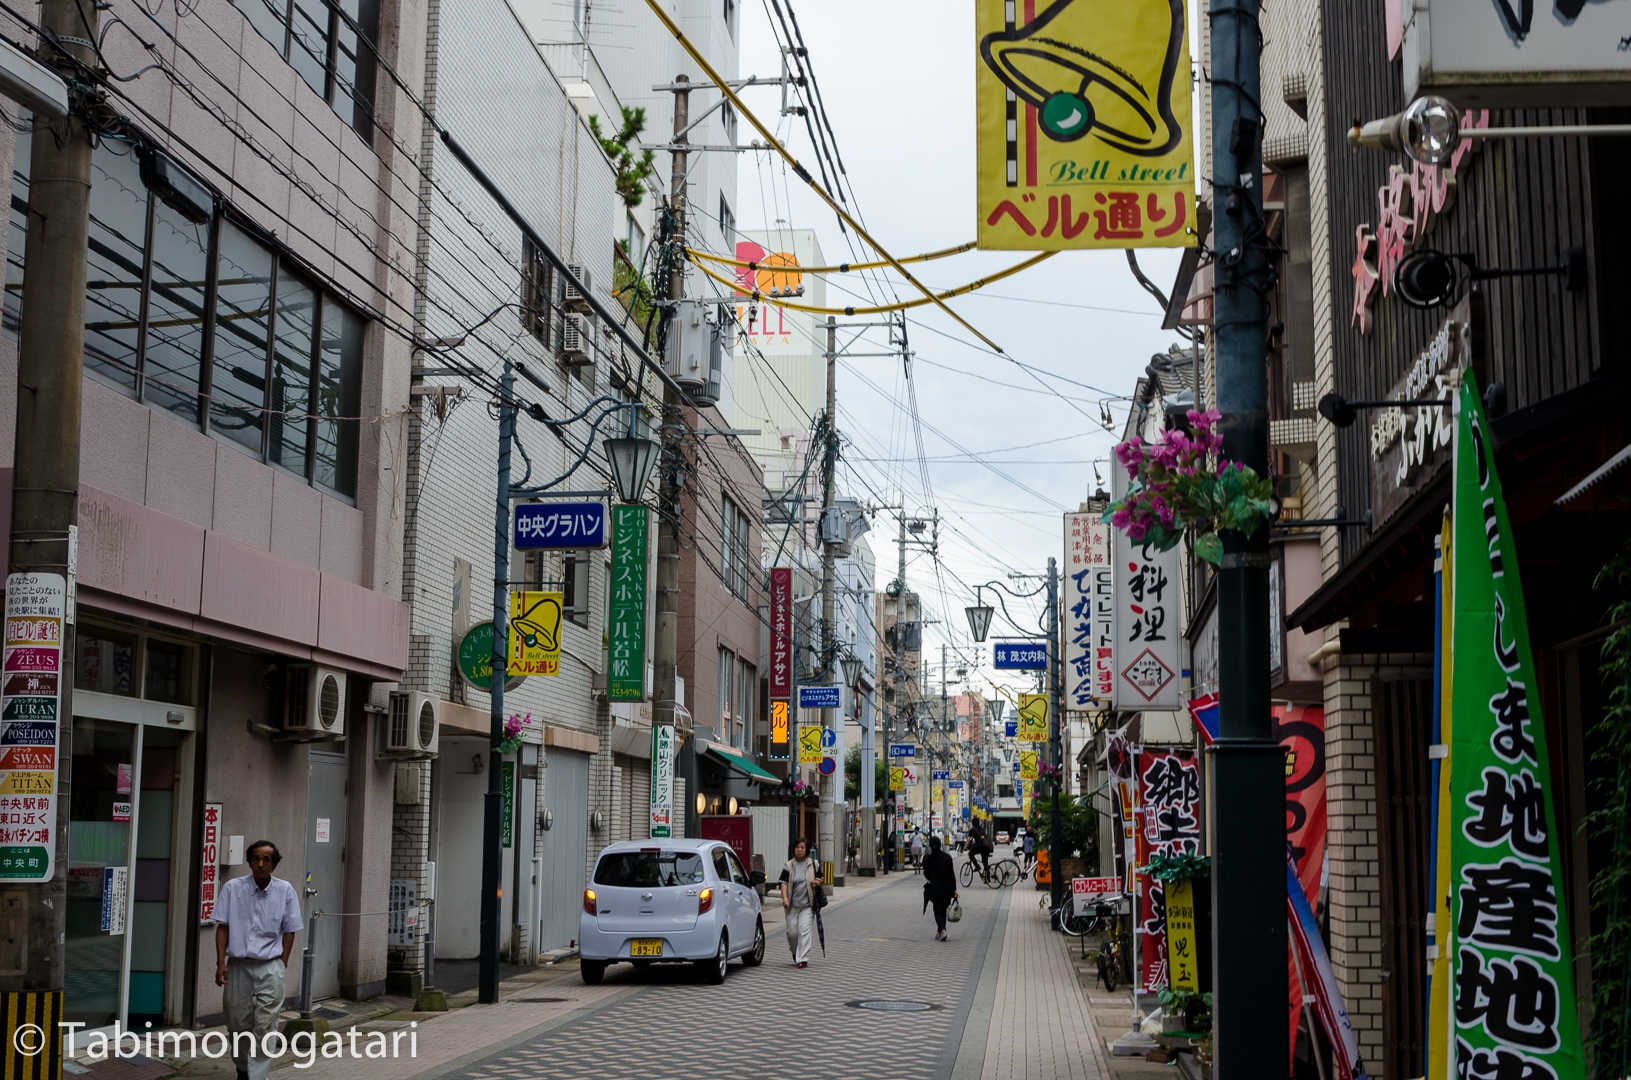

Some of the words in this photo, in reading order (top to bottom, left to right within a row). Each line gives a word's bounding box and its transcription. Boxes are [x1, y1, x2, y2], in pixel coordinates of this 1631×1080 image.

[1050, 160, 1110, 183] Bell
[1120, 161, 1188, 181] street
[987, 191, 1188, 240] ベル通り
[517, 514, 601, 539] 中央グラハン
[636, 509, 645, 556] HOTEL
[613, 508, 635, 677] ビジネスホテル若松
[1128, 543, 1168, 642] 料理
[633, 563, 643, 650] WAKAMATSU
[17, 655, 54, 665] ZEUS
[510, 660, 558, 674] ベル通り
[774, 651, 787, 686] アサヒ
[14, 704, 55, 715] JURAN
[8, 729, 54, 740] POSEIDON
[13, 753, 52, 764] SWAN
[11, 778, 52, 789] TITAN
[0, 797, 50, 810] 中央駅前
[119, 805, 130, 813] AED
[0, 812, 47, 825] 東口近く
[3, 857, 39, 868] 中央町
